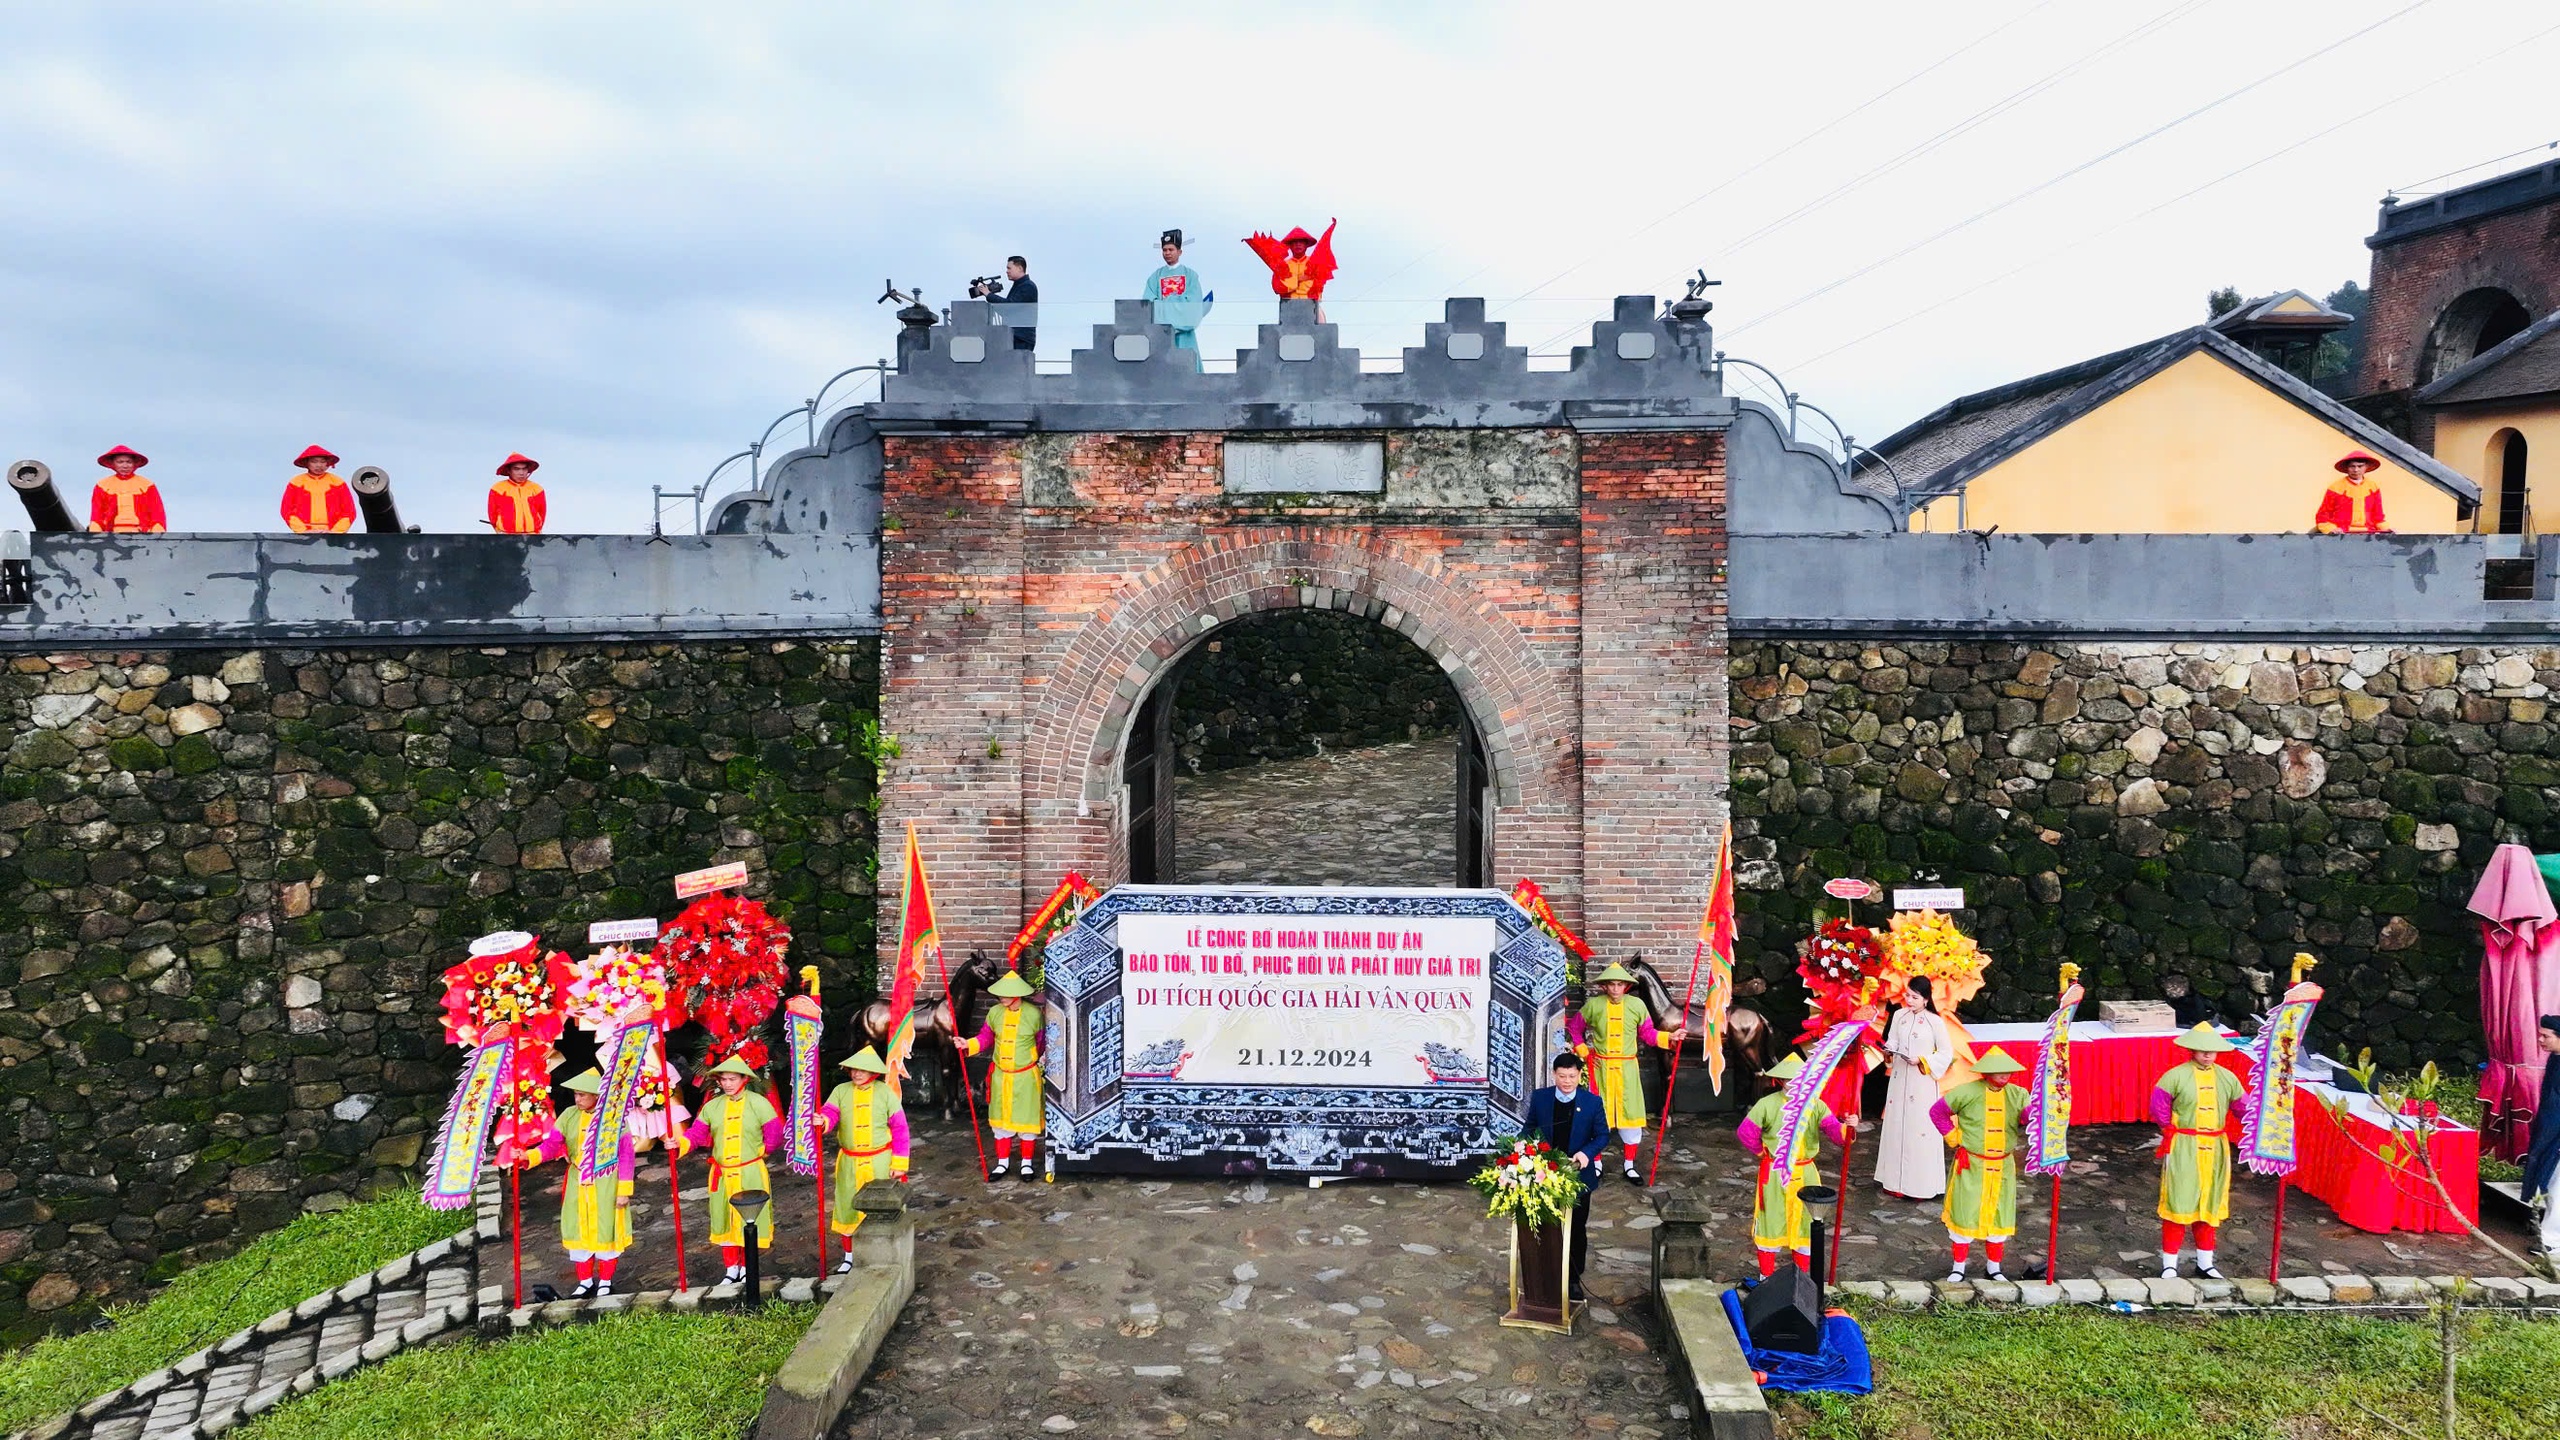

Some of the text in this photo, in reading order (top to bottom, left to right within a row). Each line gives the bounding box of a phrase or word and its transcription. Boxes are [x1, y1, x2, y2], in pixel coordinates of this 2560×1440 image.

[1207, 928, 1247, 949] CÔNG
[1252, 927, 1273, 949] BỐ
[1277, 928, 1318, 949] HOÀN
[1323, 928, 1372, 950] THÀNH
[1377, 930, 1400, 953] DỰ
[1402, 929, 1423, 951] ÁN
[1129, 950, 1159, 974] BẢO
[1201, 955, 1219, 974] TU
[1253, 956, 1293, 978] PHỤC
[1297, 952, 1323, 975] HỒI
[1327, 954, 1346, 975] VÀ
[1351, 954, 1390, 976] PHÁT
[1394, 957, 1424, 977] HUY
[1428, 955, 1453, 977] GIÁ
[1458, 957, 1482, 980] TRỊ
[1137, 981, 1473, 1012] DI TÍCH QUỐC GIA HẢI VÂN QUAN
[1238, 1047, 1373, 1068] 21.12.2024
